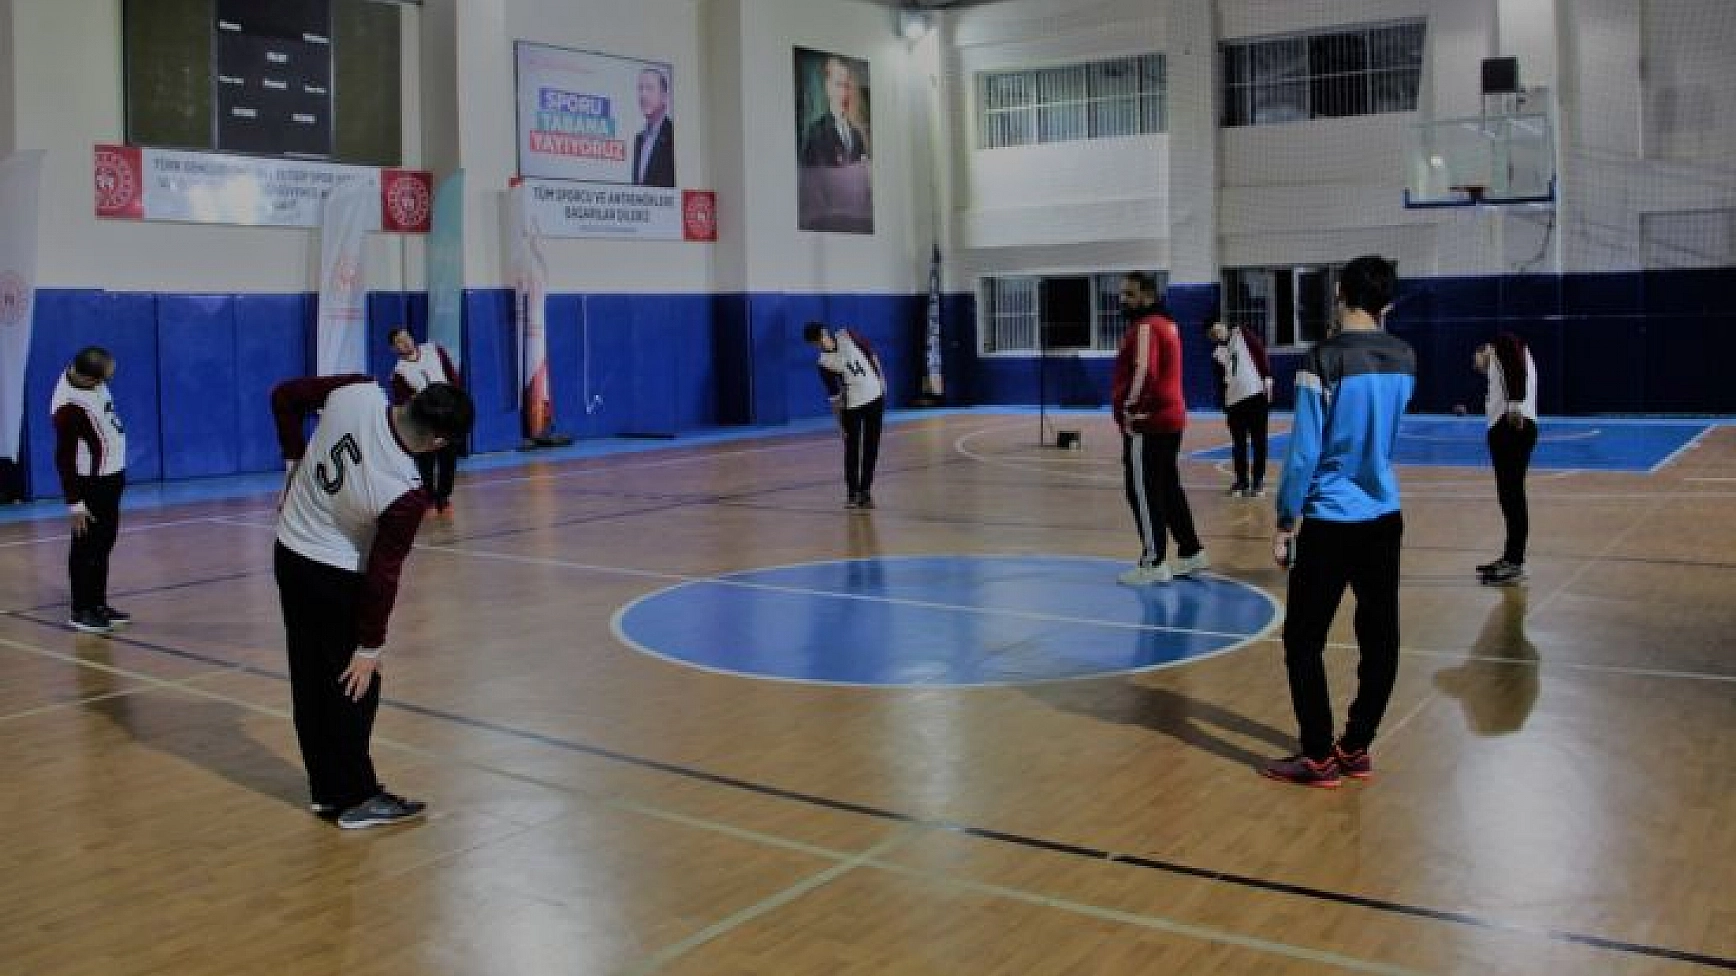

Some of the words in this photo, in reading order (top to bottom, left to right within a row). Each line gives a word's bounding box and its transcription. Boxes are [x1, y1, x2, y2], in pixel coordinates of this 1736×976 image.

[545, 91, 602, 116] SPORU
[846, 359, 867, 377] 4
[316, 432, 362, 495] 5
